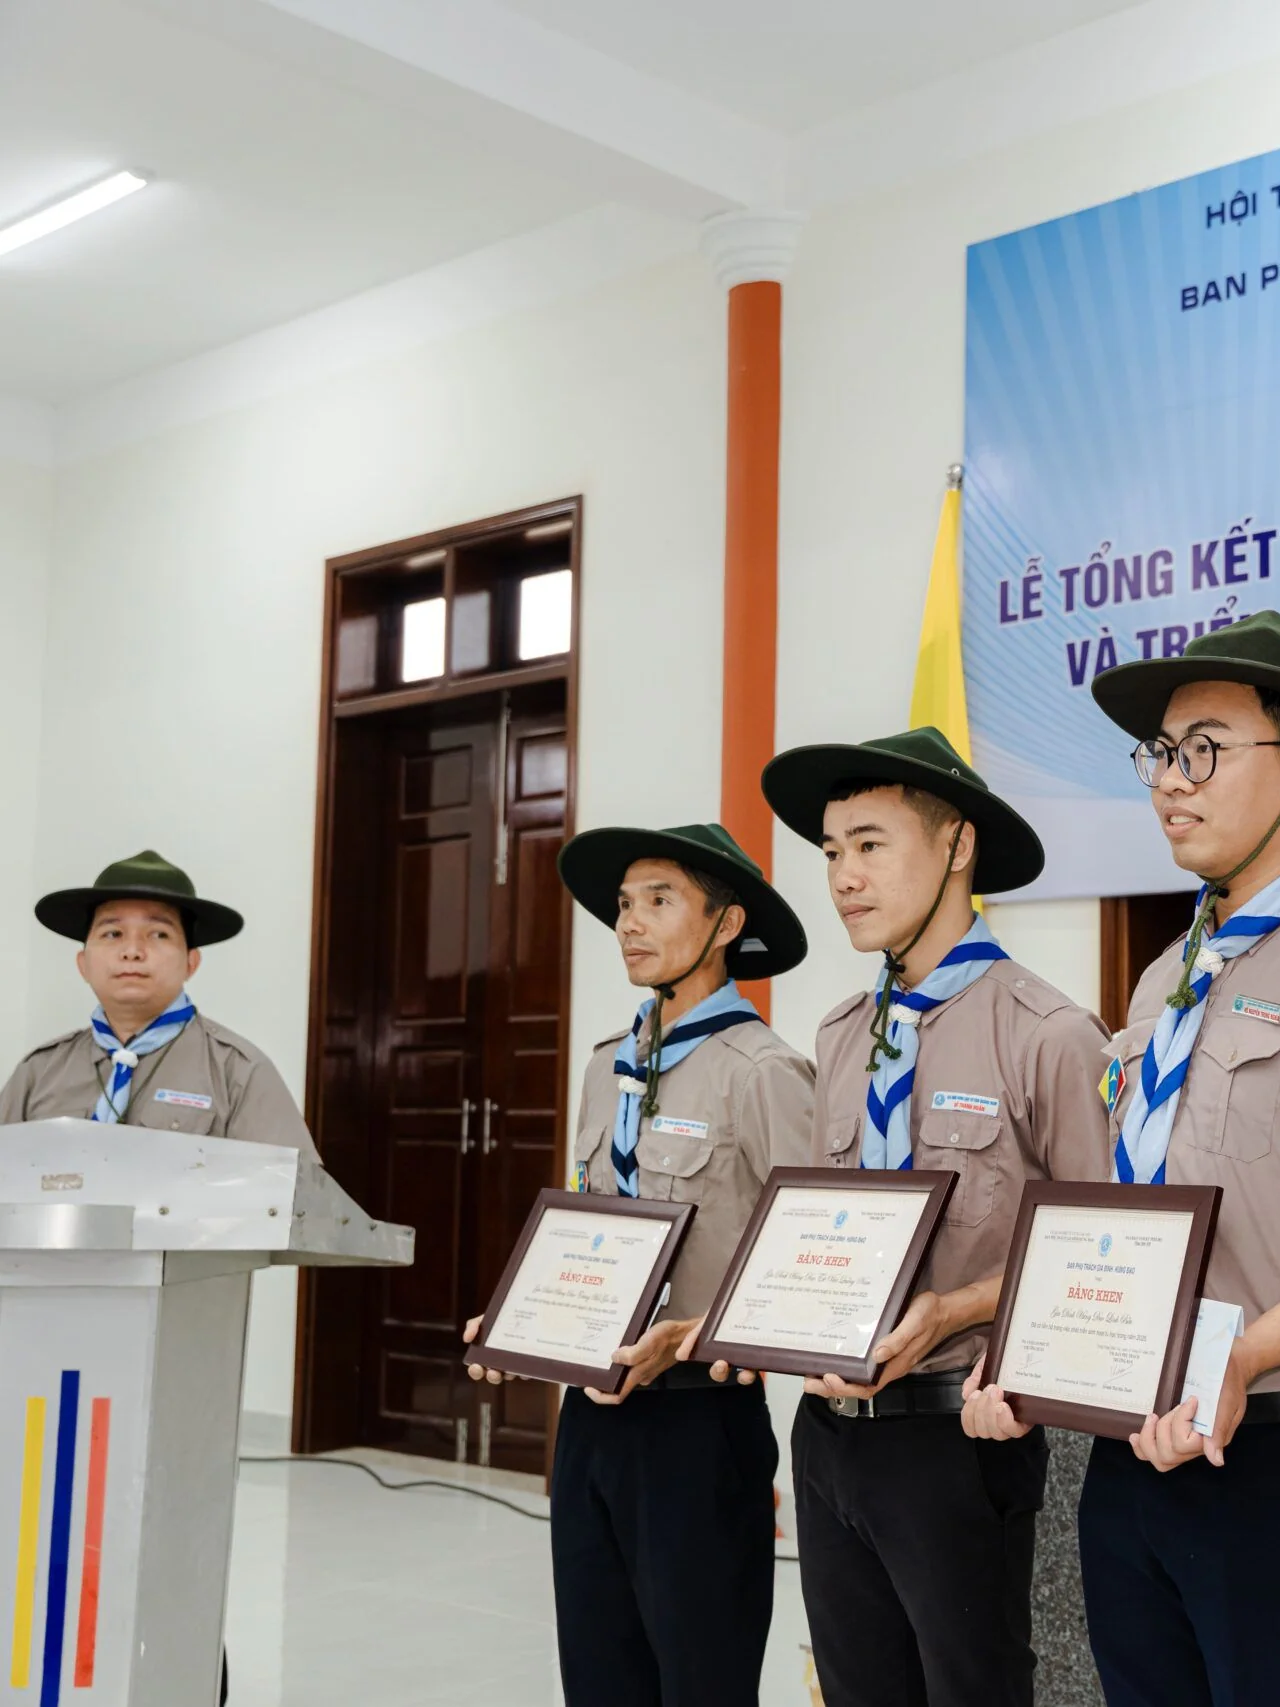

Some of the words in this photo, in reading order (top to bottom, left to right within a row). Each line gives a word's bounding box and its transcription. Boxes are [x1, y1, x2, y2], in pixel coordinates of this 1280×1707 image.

[1206, 190, 1257, 229] HỘI
[1180, 272, 1247, 312] BAN
[999, 556, 1043, 625] LỄ
[1058, 540, 1174, 613] TỔNG
[1191, 517, 1277, 592] KẾT
[1066, 626, 1119, 687] VÀ
[1095, 1289, 1124, 1304] KHEN
